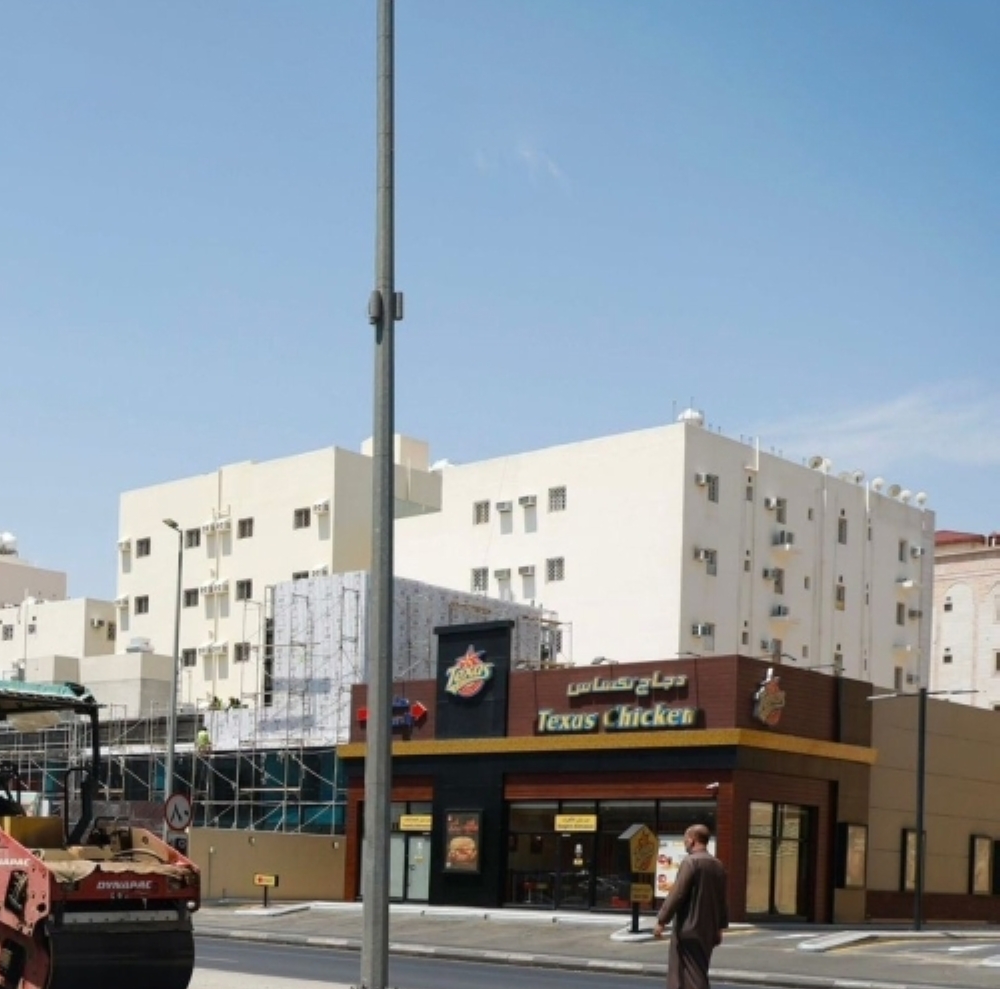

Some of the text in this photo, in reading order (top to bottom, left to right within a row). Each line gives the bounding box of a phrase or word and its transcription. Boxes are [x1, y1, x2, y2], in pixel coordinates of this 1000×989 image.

[635, 670, 687, 695] دجاج
[537, 702, 696, 732] Texas Chicken
[97, 879, 152, 890] DYNAPAC
